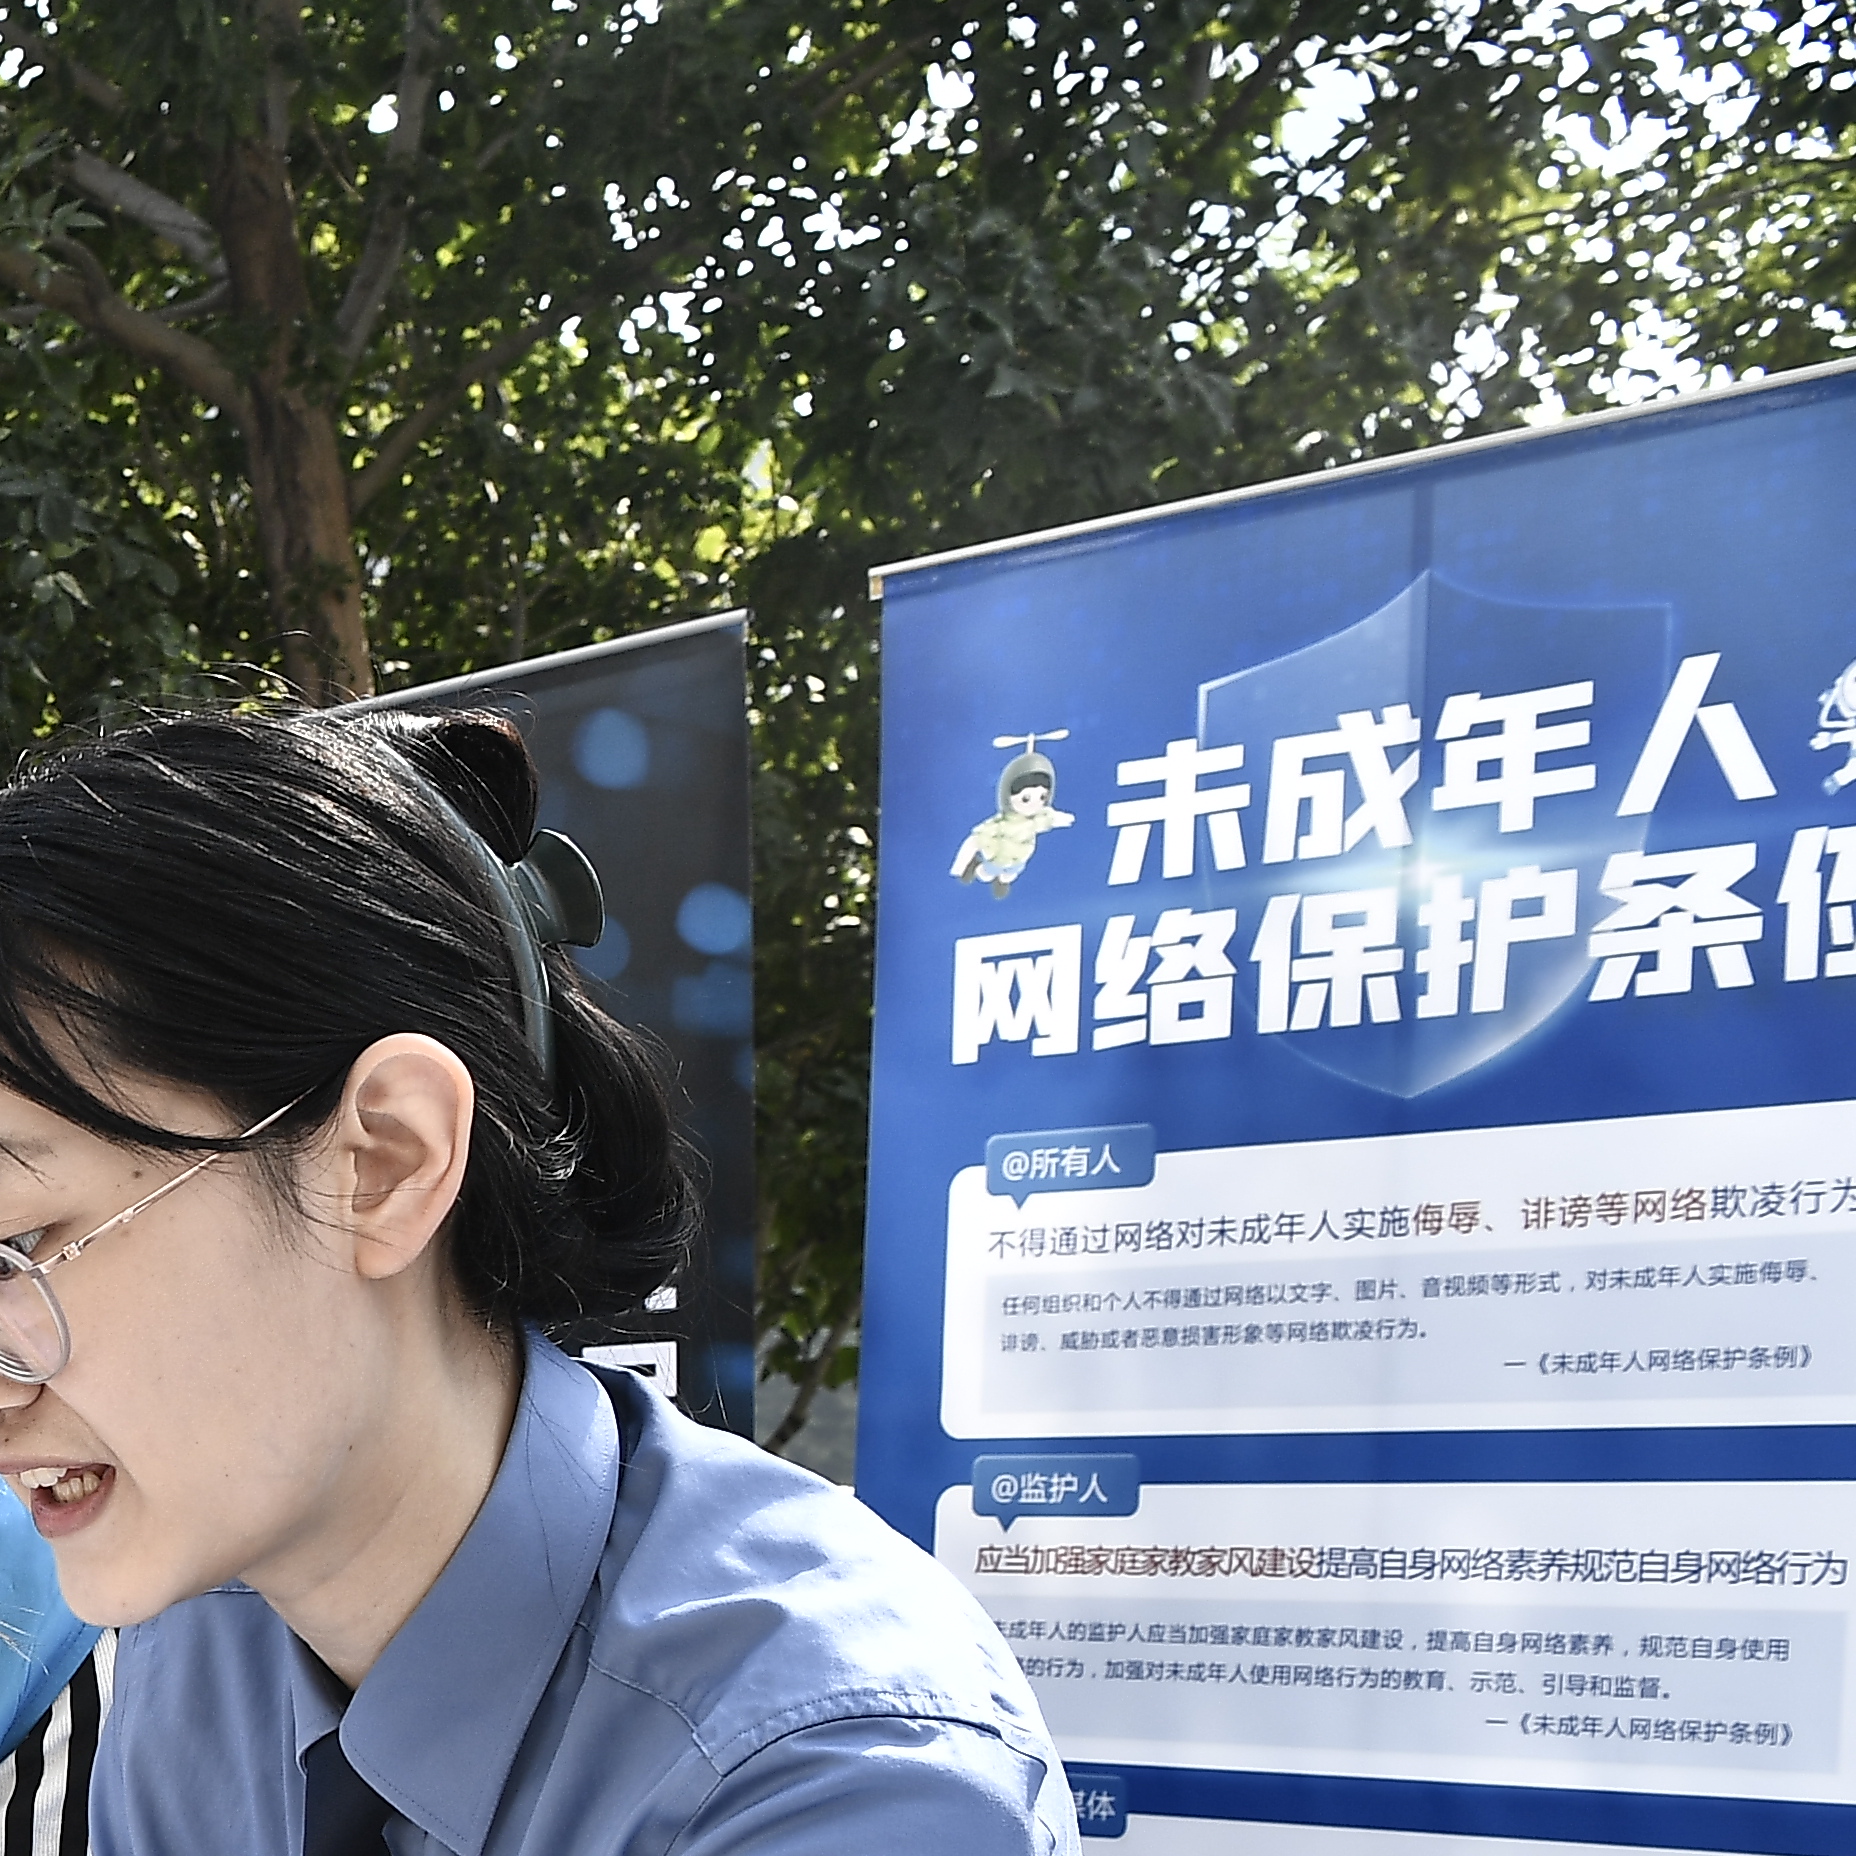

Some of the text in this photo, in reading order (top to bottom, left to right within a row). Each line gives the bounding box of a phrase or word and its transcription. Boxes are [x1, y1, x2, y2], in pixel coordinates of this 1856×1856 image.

[1106, 652, 1778, 887] 未成年人
[1001, 1143, 1122, 1182] @所有人
[991, 1472, 1108, 1504] @监护人
